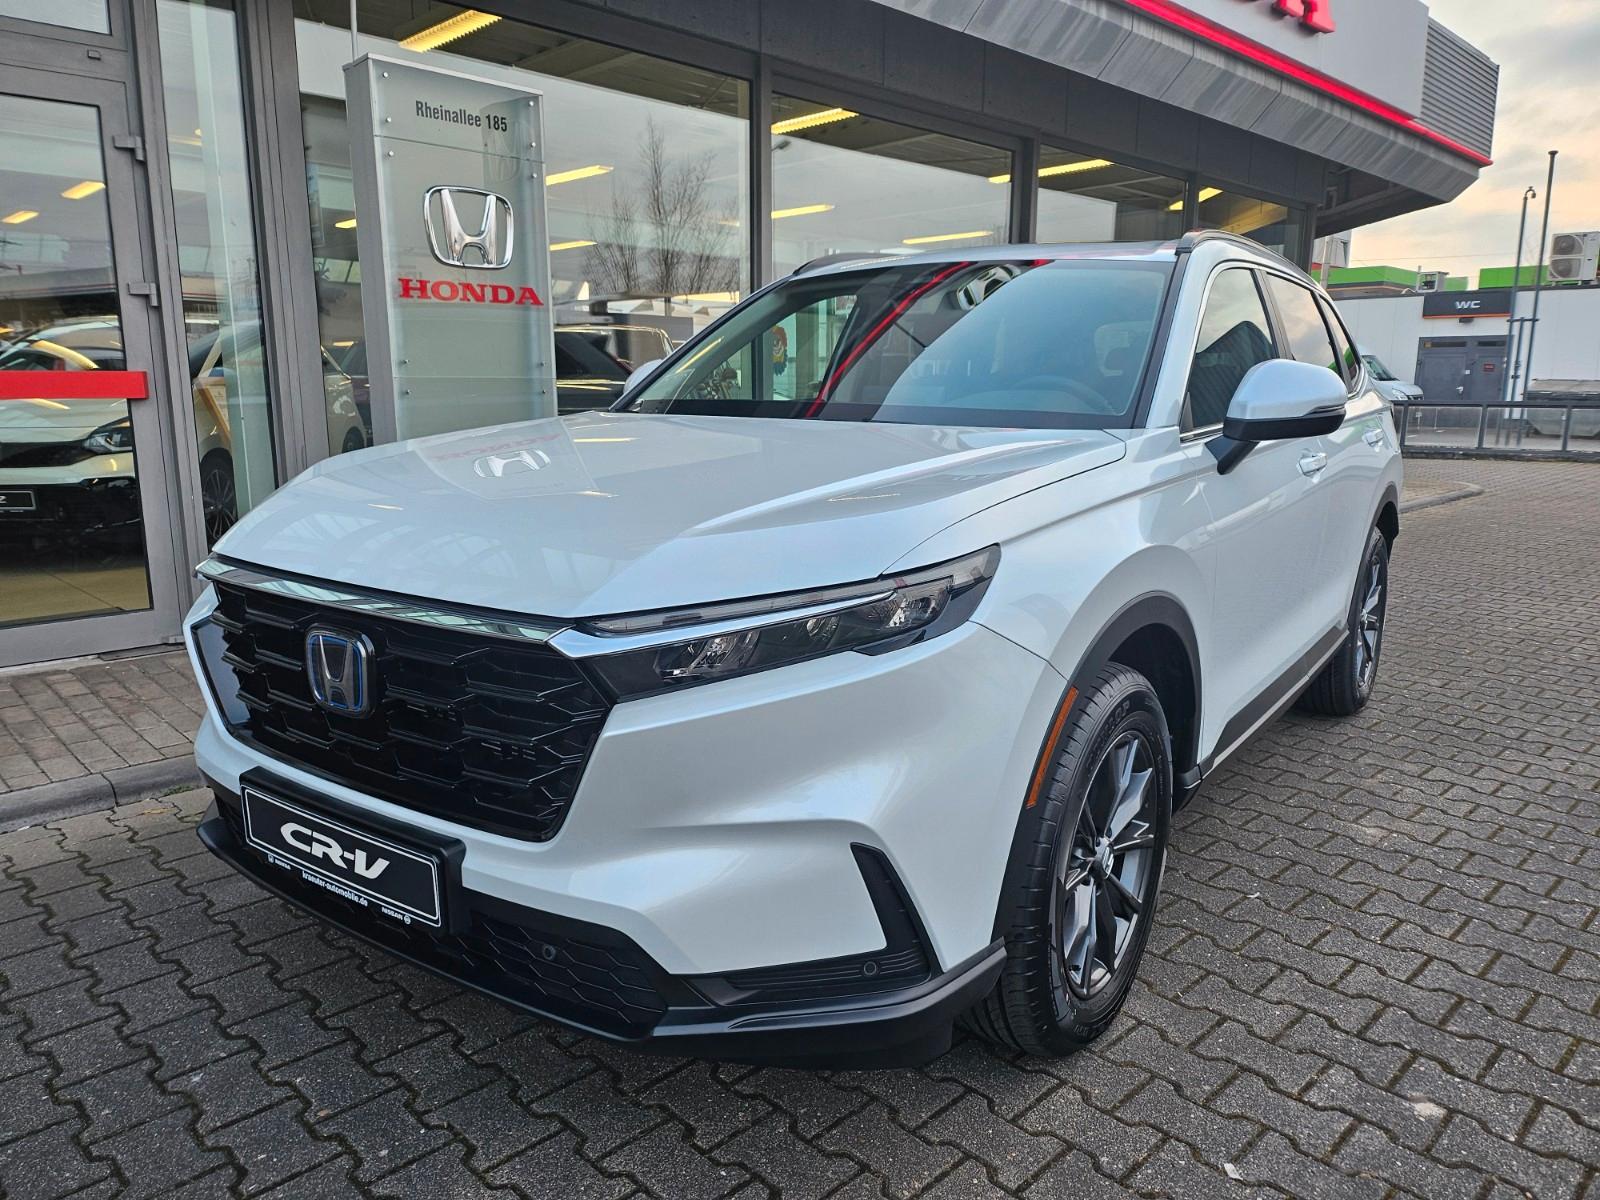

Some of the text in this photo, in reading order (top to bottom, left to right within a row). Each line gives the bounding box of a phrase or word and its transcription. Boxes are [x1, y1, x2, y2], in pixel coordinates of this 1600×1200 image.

[415, 100, 508, 132] Rheinallee 185
[398, 277, 544, 306] HONDA
[1455, 300, 1481, 309] WC
[280, 822, 390, 879] CR-V
